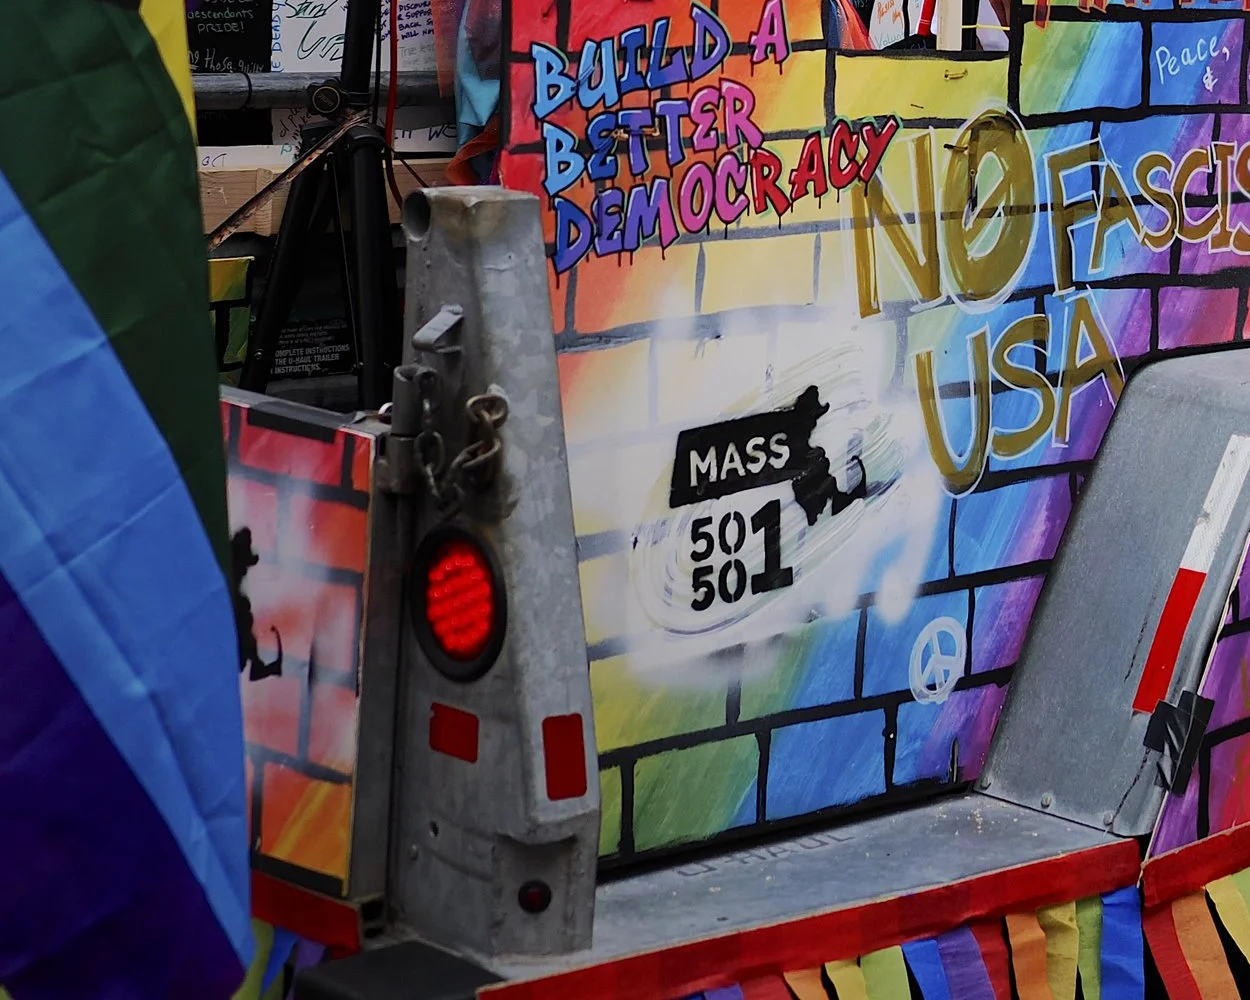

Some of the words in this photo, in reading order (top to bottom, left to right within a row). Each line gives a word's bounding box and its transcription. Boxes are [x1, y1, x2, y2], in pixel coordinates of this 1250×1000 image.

[197, 21, 245, 34] PRIDE!
[398, 22, 421, 32] BACK
[1155, 36, 1230, 85] Peace,
[542, 78, 764, 197] BETTER
[552, 114, 901, 276] DEMOCRACY
[850, 107, 1040, 320] NO
[912, 287, 1127, 498] USA
[689, 432, 791, 488] MASS
